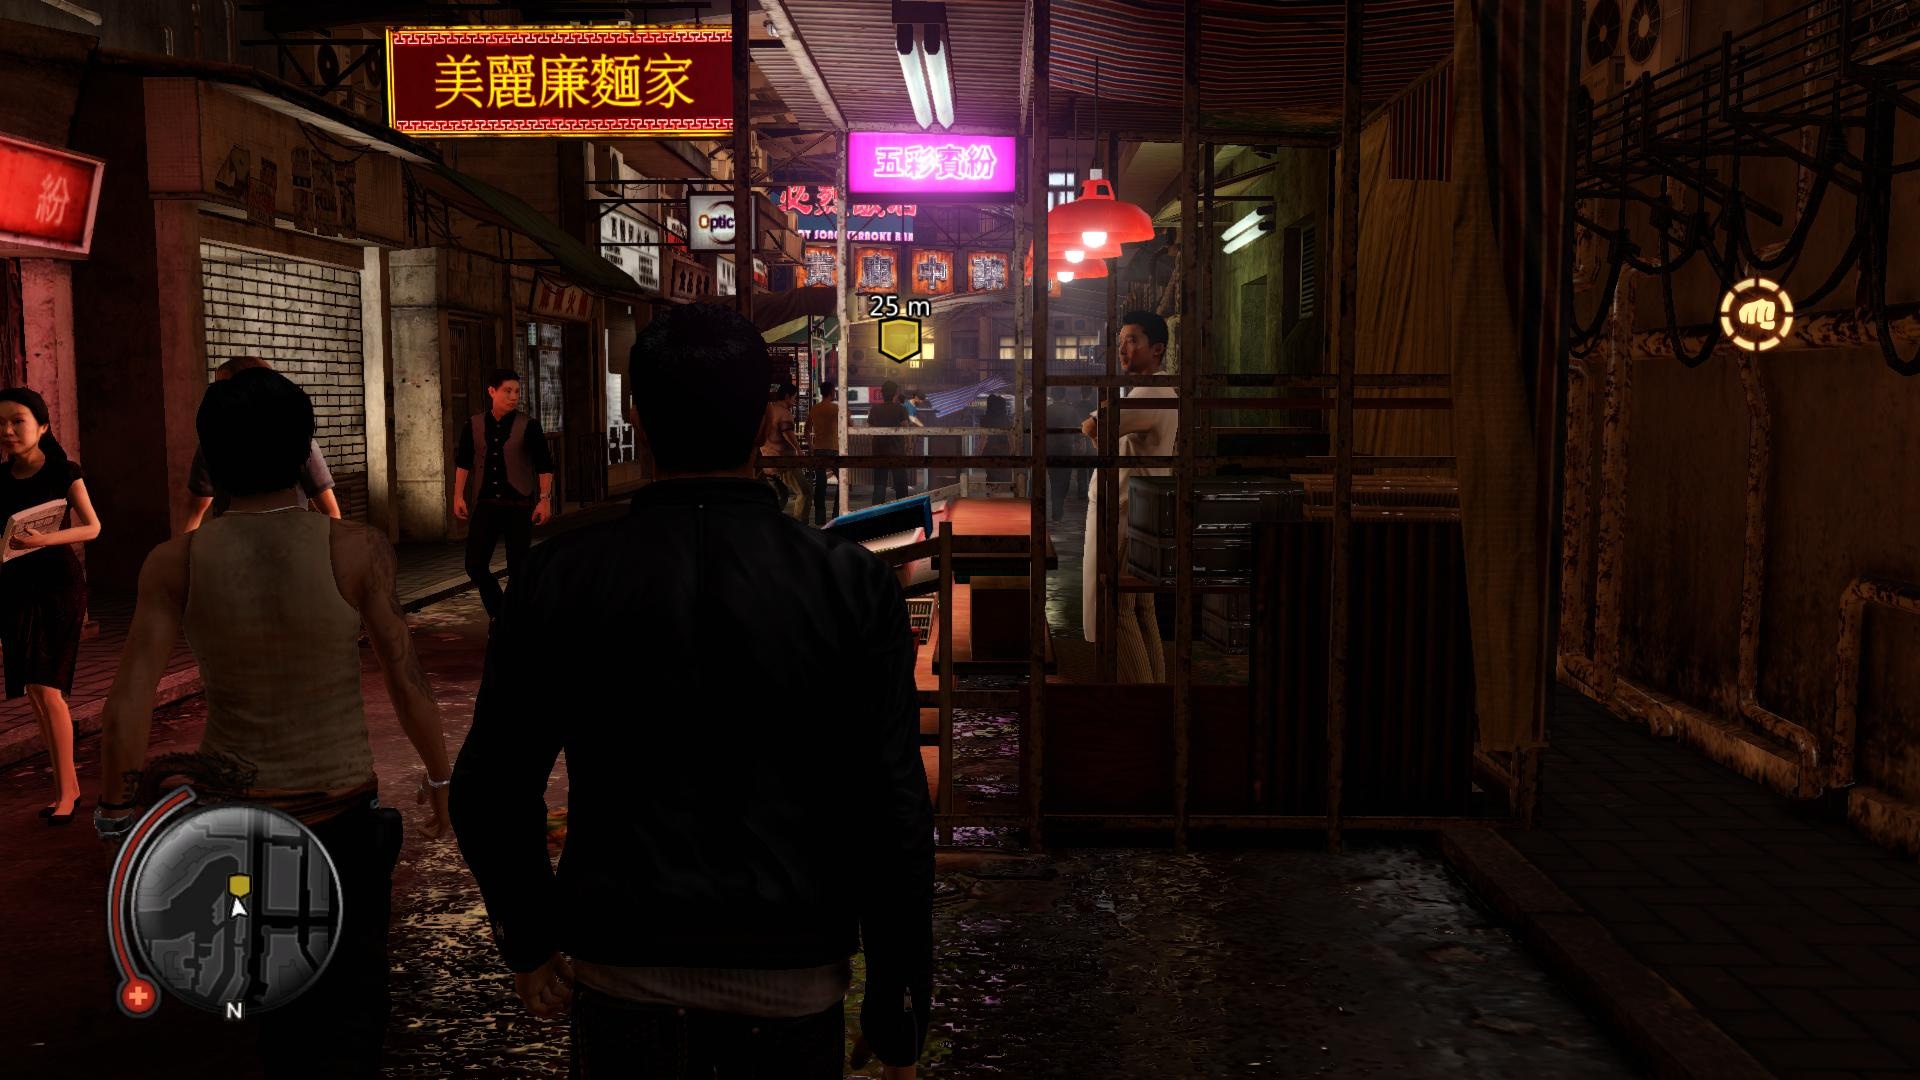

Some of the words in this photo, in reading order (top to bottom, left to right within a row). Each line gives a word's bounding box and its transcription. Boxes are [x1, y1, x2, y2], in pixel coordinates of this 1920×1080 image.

[435, 52, 694, 109] 美麗廉麵家
